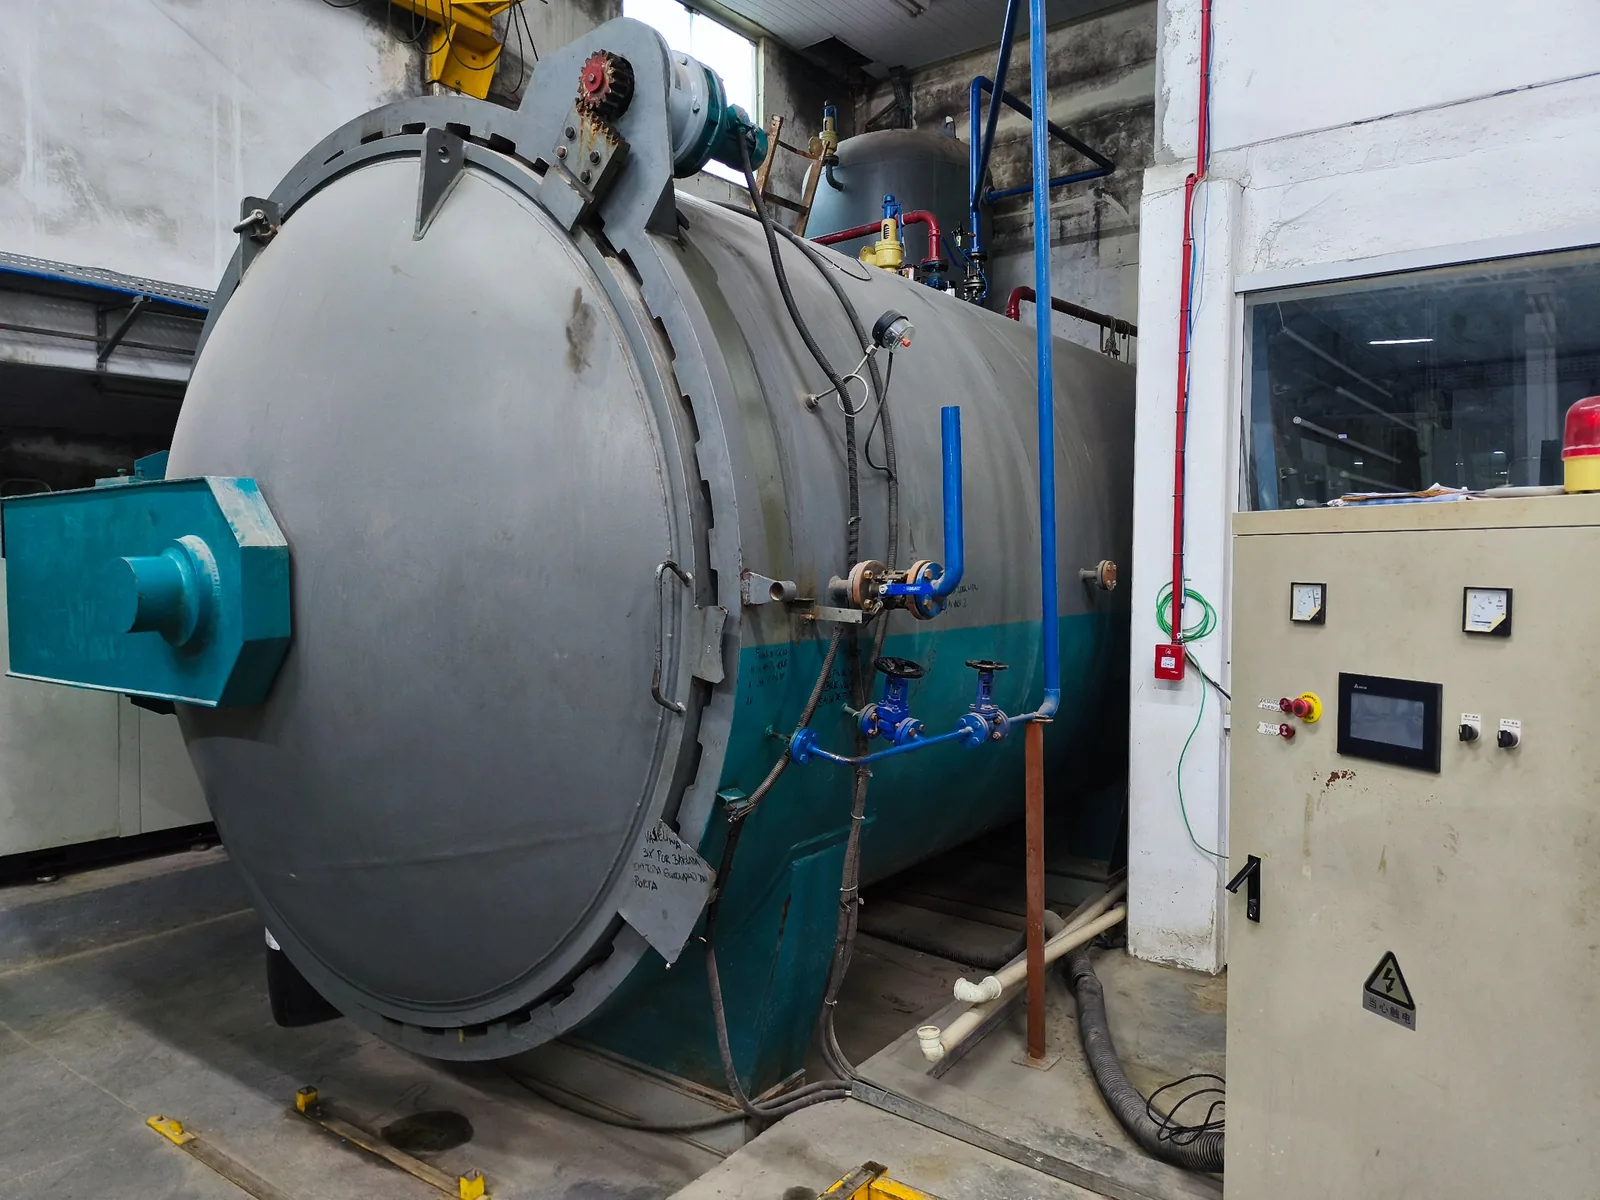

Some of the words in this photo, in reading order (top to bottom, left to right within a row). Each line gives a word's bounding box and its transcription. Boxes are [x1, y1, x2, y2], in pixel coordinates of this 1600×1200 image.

[634, 874, 658, 891] PORTA
[1369, 997, 1411, 1025] 当心触电
